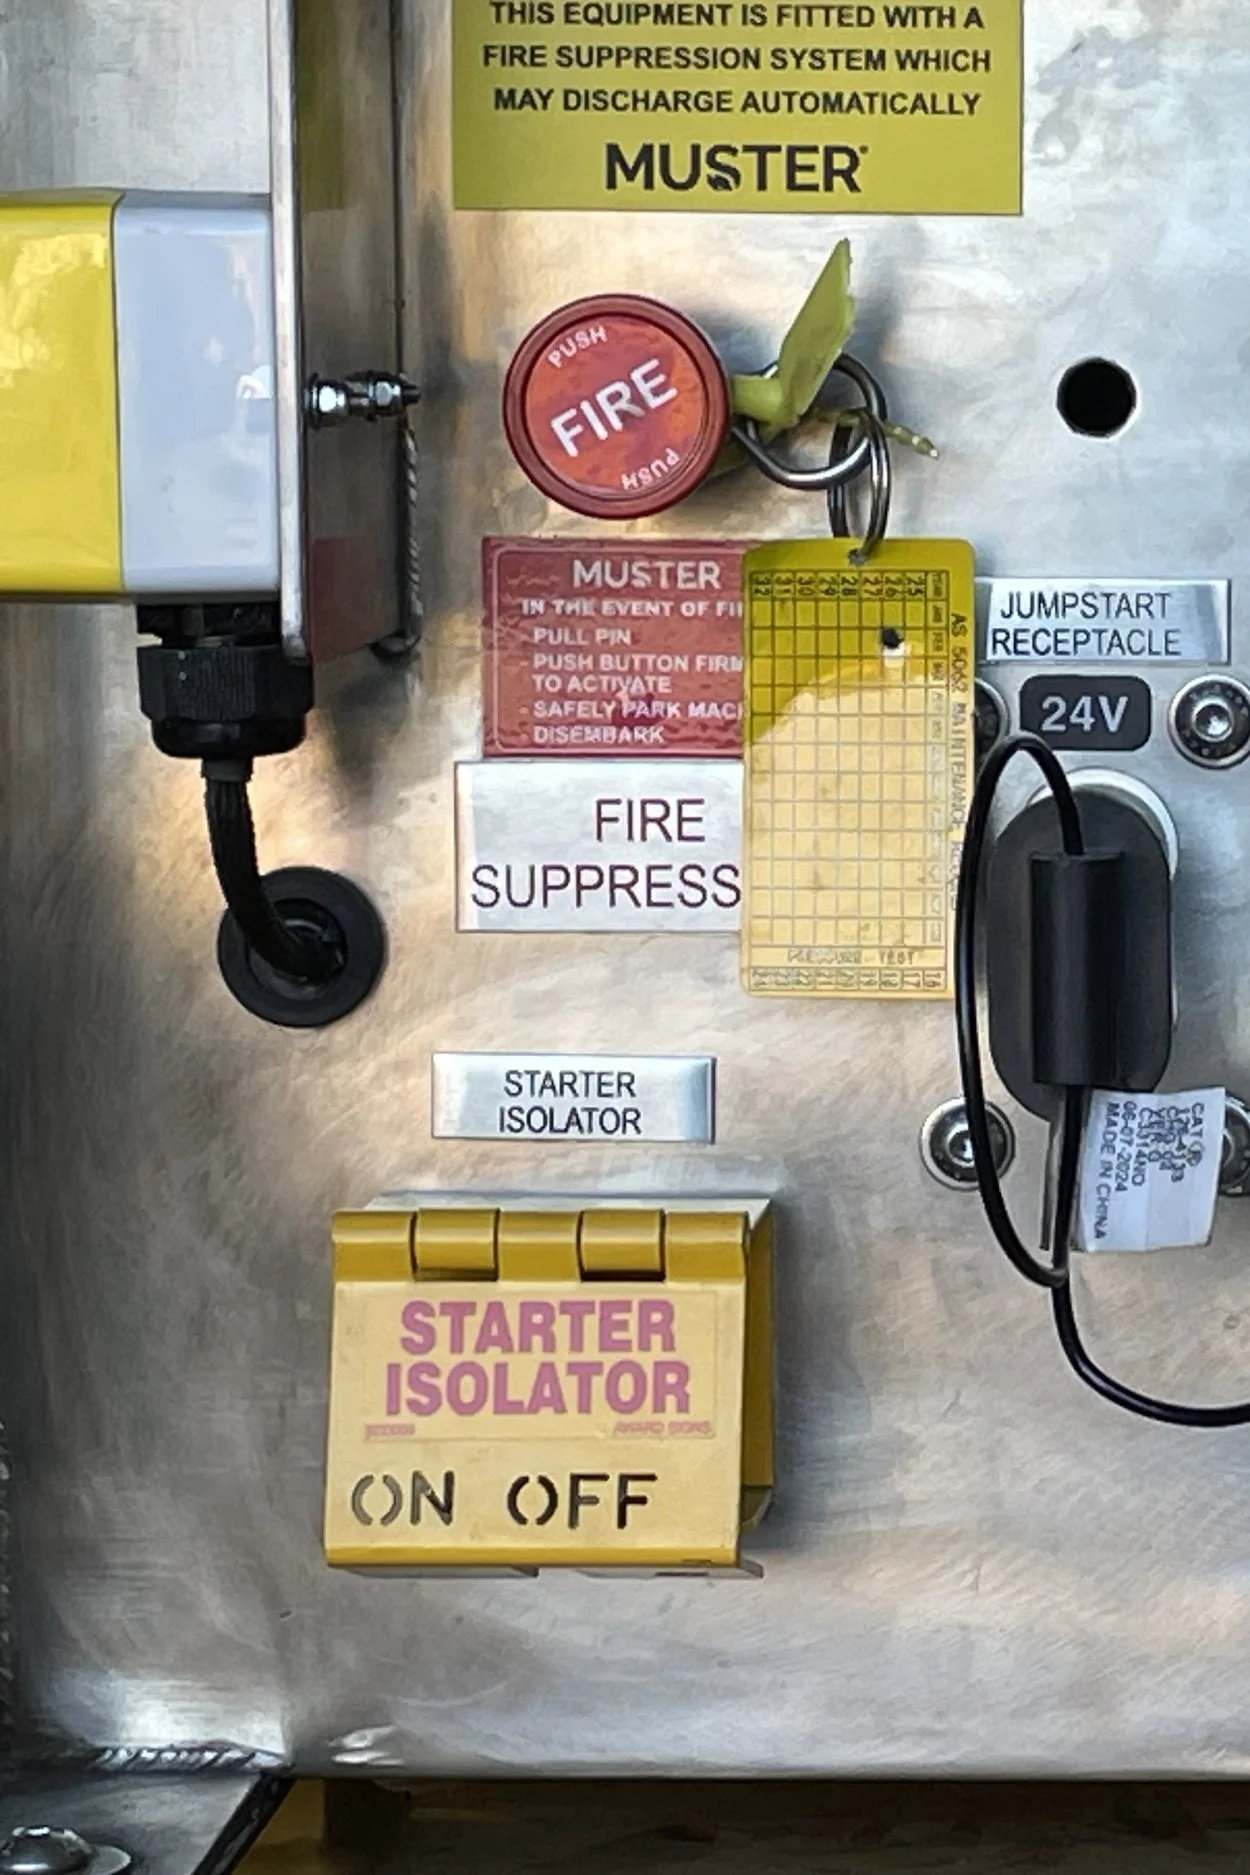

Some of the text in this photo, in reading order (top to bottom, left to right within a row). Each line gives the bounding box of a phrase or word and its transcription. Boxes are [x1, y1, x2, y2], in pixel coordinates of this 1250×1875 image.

[489, 2, 984, 29] THIS EQUIPMENT IS FITTED WITH A
[482, 45, 991, 73] FIRE SUPPRESSION SYSTEM WHICH
[494, 88, 981, 116] MAY DISCHARGE AUTOMATICALLY
[548, 326, 608, 368] PUSH
[551, 358, 678, 457] FIRE
[621, 448, 681, 490] PUSH
[573, 560, 721, 589] MUSTER
[521, 599, 743, 617] IN THE EVENT OF FI
[1000, 591, 1172, 620] JUMPSTART
[533, 628, 631, 645] PULL PIN
[951, 613, 968, 638] AS
[991, 628, 1182, 656] RECEPTACLE
[533, 654, 593, 671] PUSH
[602, 655, 688, 672] BUTTON
[531, 674, 672, 694] TO ACTIVATE
[534, 700, 744, 720] SAFELY PARK MAC
[1041, 696, 1128, 733] 24V
[534, 725, 665, 745] DISEMBARK
[951, 703, 967, 833] MAINTENANCE
[595, 797, 706, 843] FIRE
[504, 1069, 636, 1099] STARTER
[499, 1105, 642, 1135] ISOLATOR
[1094, 1102, 1120, 1239] MADE IN CHINA
[400, 1299, 676, 1355] STARTER
[385, 1360, 691, 1417] ISOLATOR
[350, 1470, 657, 1529] ON OFF
